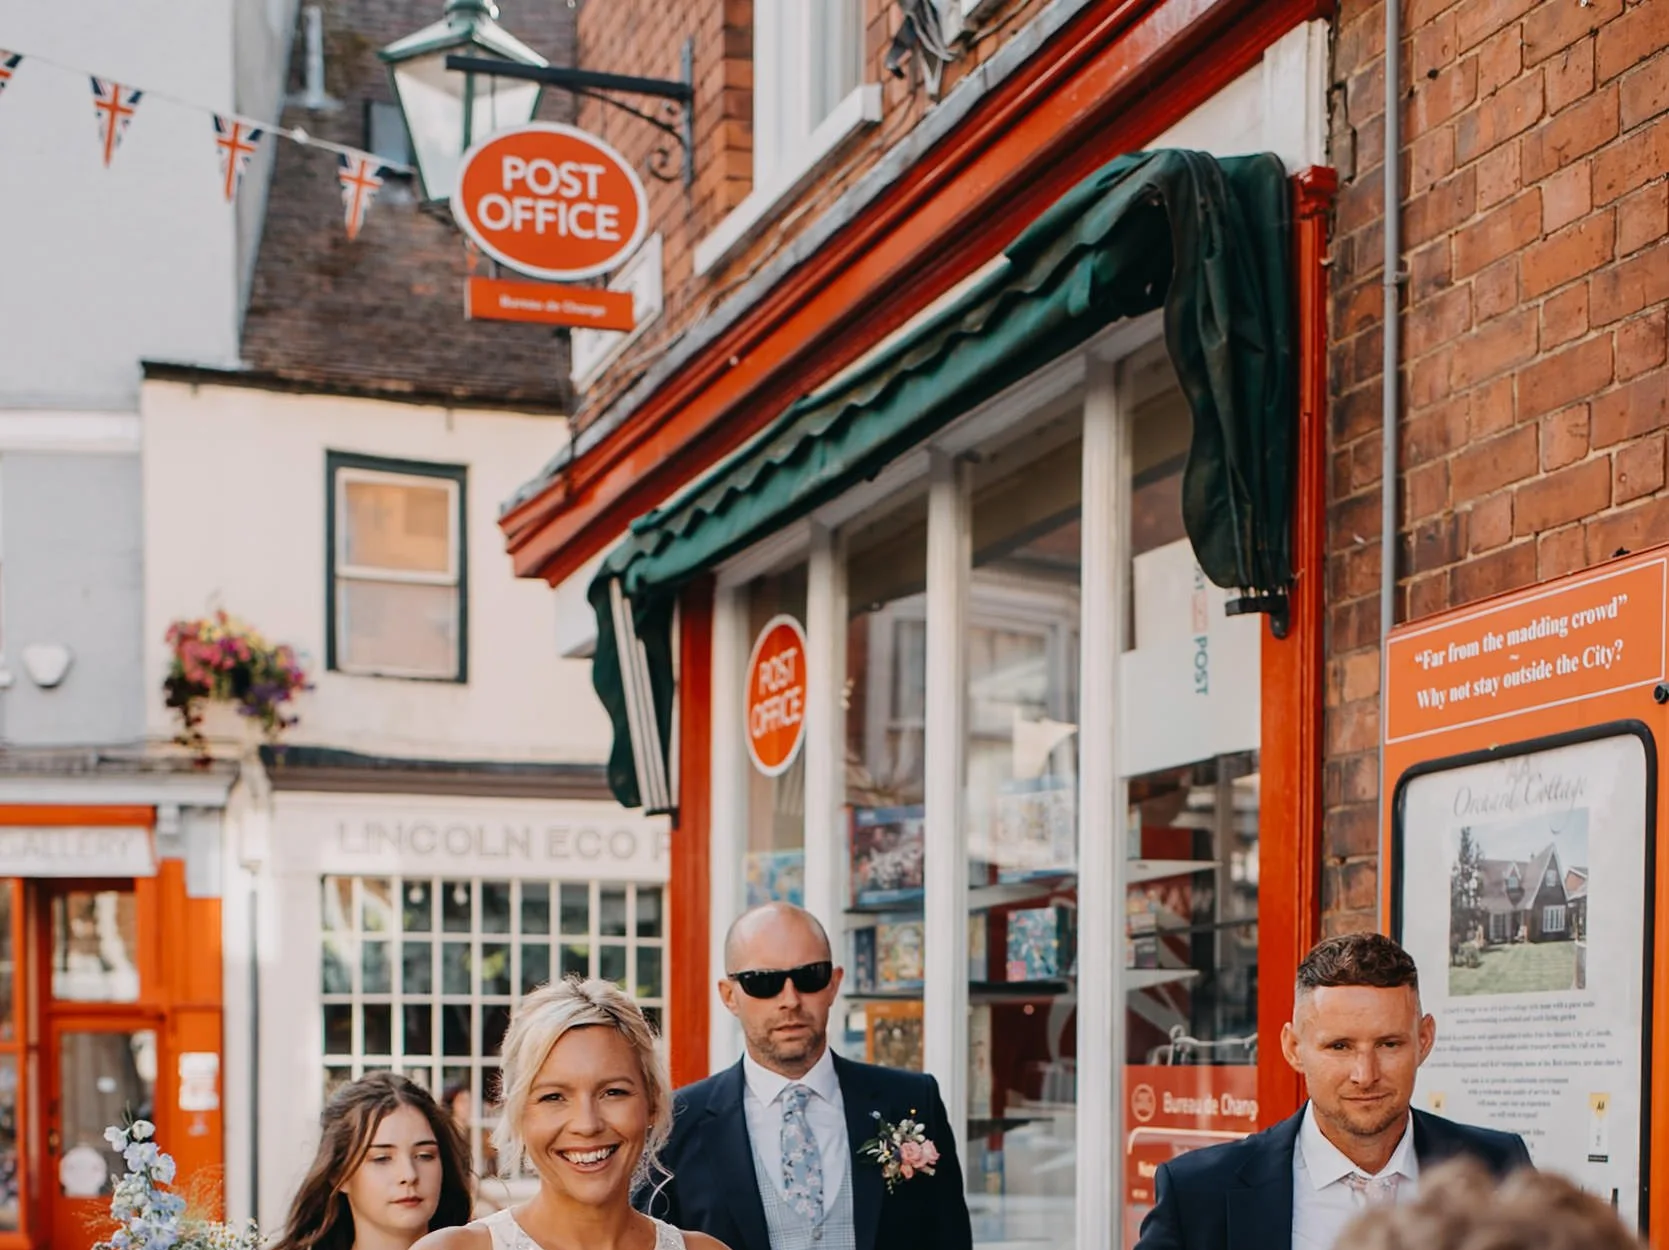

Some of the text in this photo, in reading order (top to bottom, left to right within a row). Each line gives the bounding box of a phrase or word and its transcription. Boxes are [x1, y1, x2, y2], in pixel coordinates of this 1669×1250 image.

[502, 155, 605, 199] POST
[477, 194, 620, 241] OFFICE
[1448, 642, 1479, 662] from
[1482, 632, 1504, 652] the
[1506, 615, 1568, 647] madding
[759, 648, 797, 696] POST
[1194, 636, 1208, 695] POST
[1417, 639, 1624, 710] Why not stay outside the City?
[752, 686, 801, 738] OFFICE
[338, 820, 531, 861] LINCOLN
[546, 825, 637, 861] ECO
[1163, 1091, 1202, 1114] Bureau
[1221, 1093, 1259, 1122] Chang
